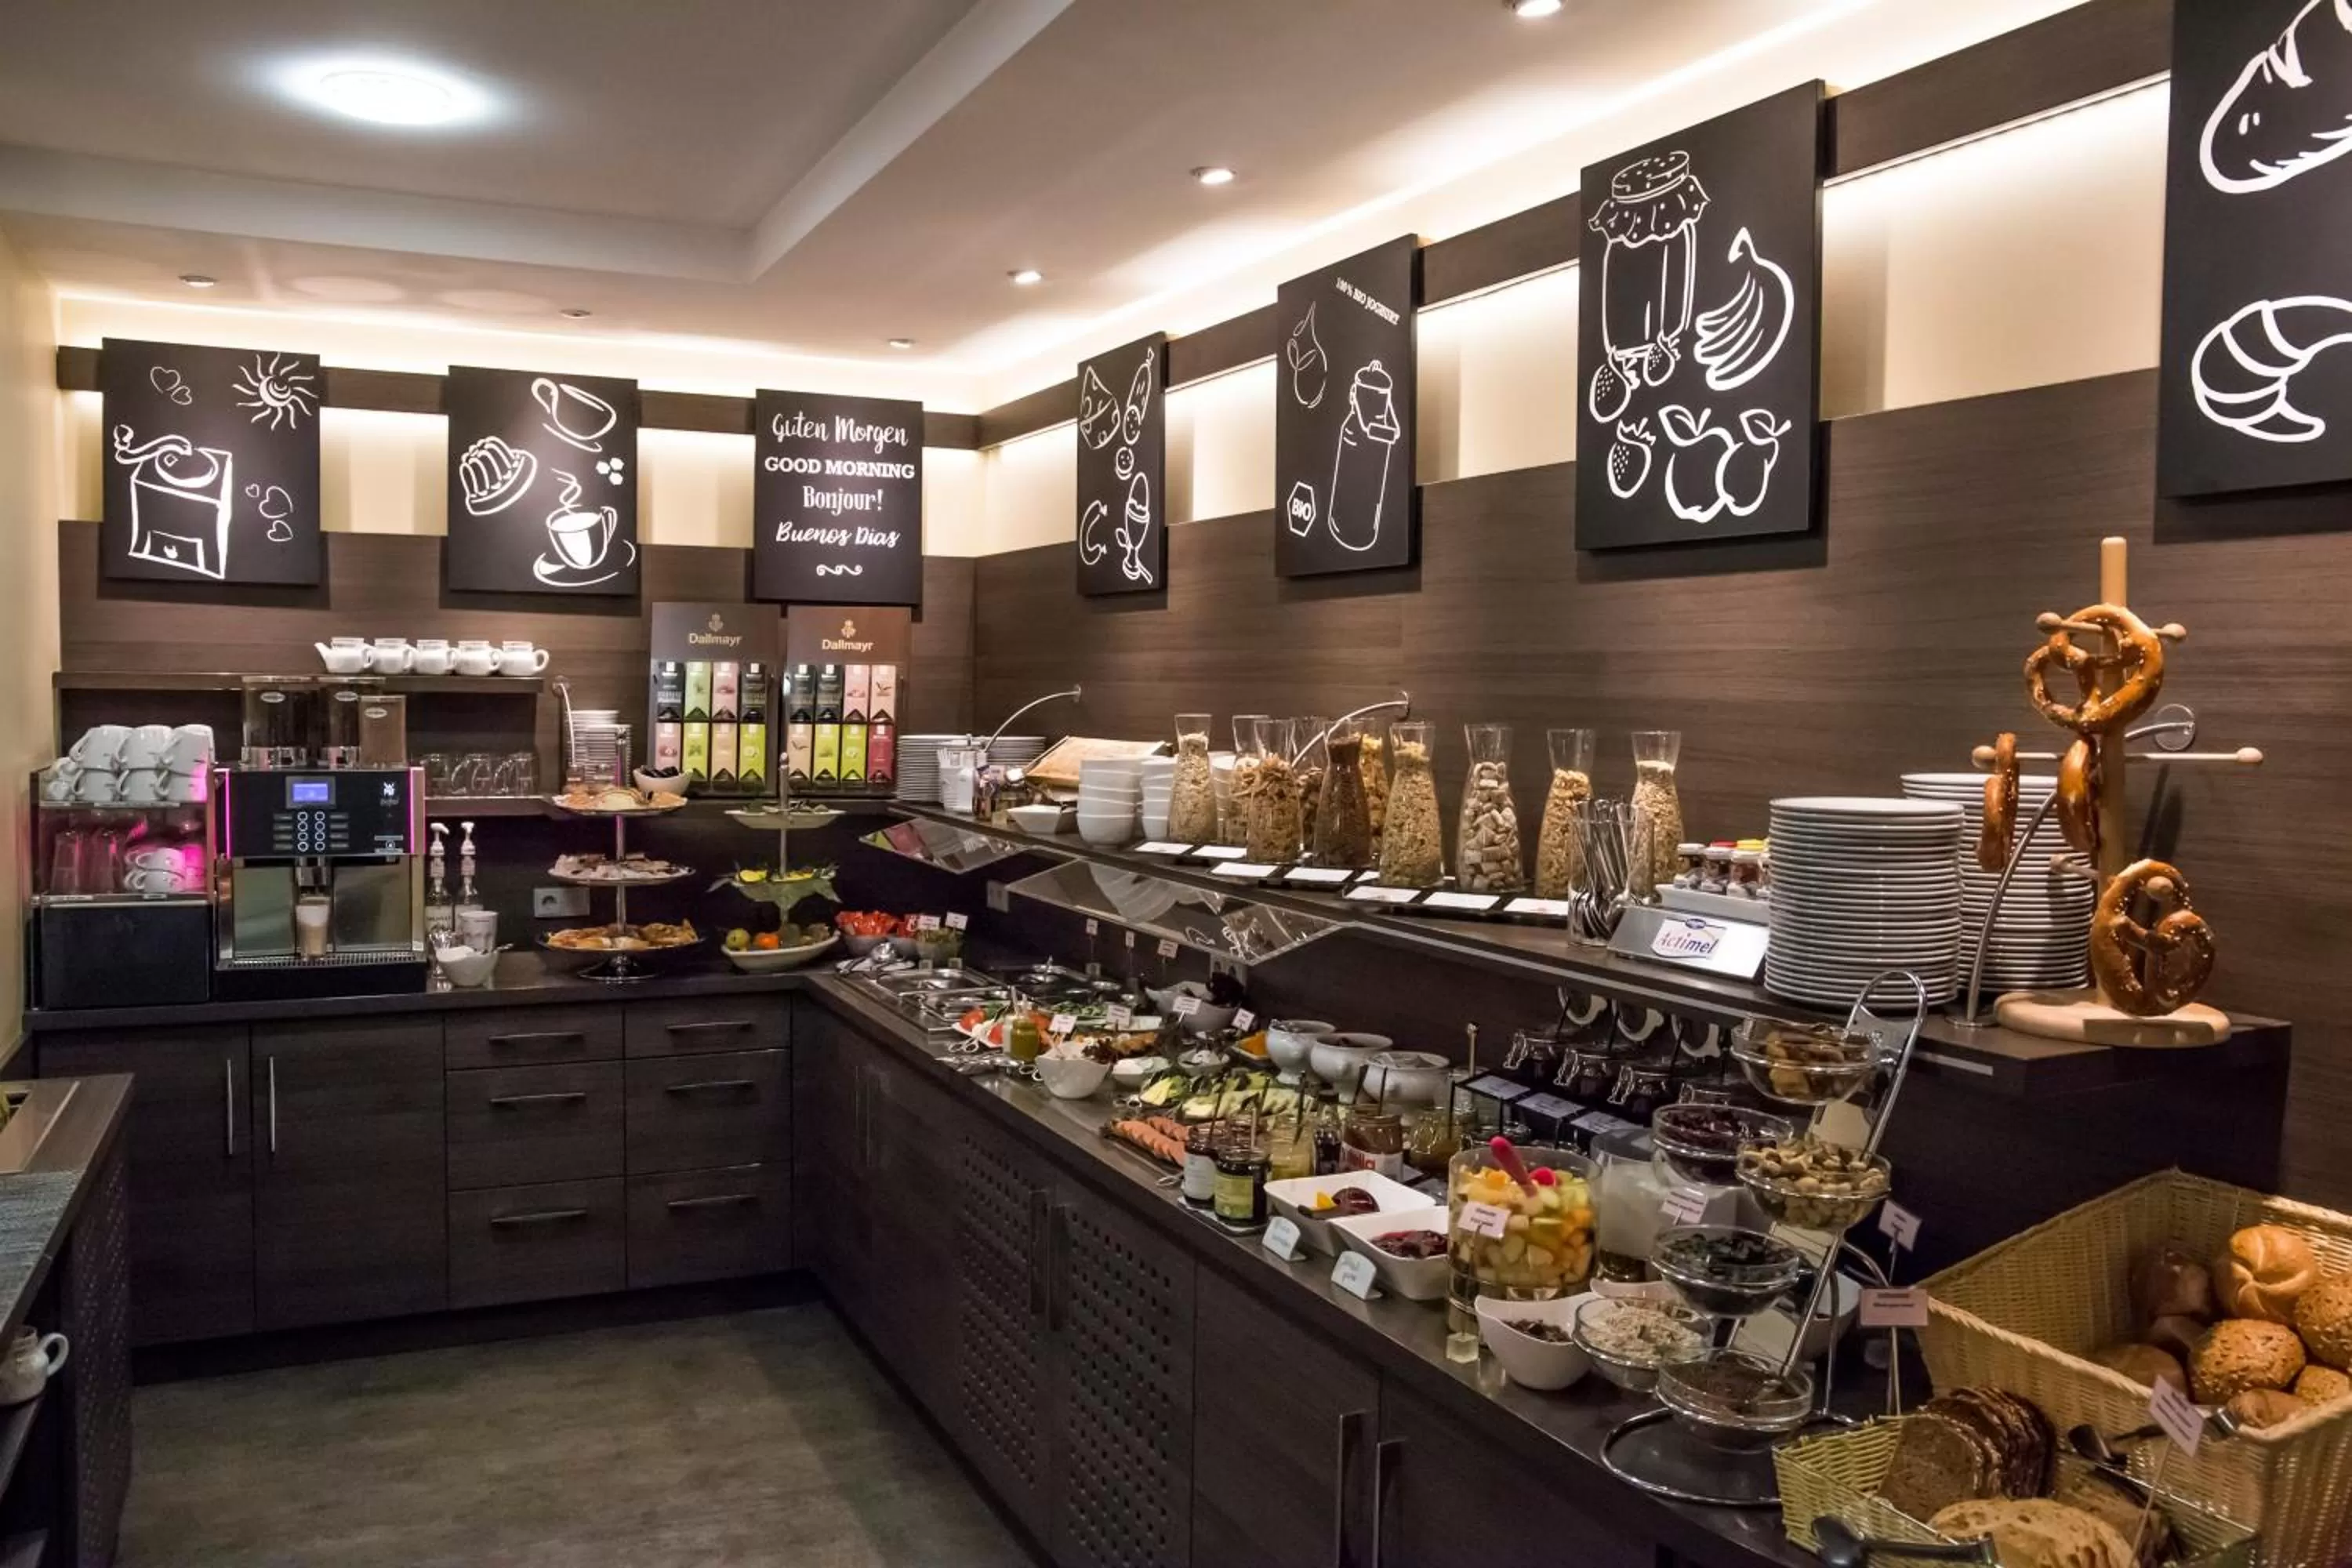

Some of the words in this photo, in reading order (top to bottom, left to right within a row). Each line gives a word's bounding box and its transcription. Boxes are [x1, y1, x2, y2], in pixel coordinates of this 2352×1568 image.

[772, 410, 829, 442] Guten
[835, 416, 909, 454] Morgen
[764, 456, 822, 474] GOOD
[825, 459, 916, 479] MORNING
[803, 485, 884, 517] Bonjour!
[1291, 498, 1312, 521] BIO
[775, 521, 853, 546] Buenos
[688, 633, 742, 647] Dallmayr
[822, 639, 873, 653] Dallmayr
